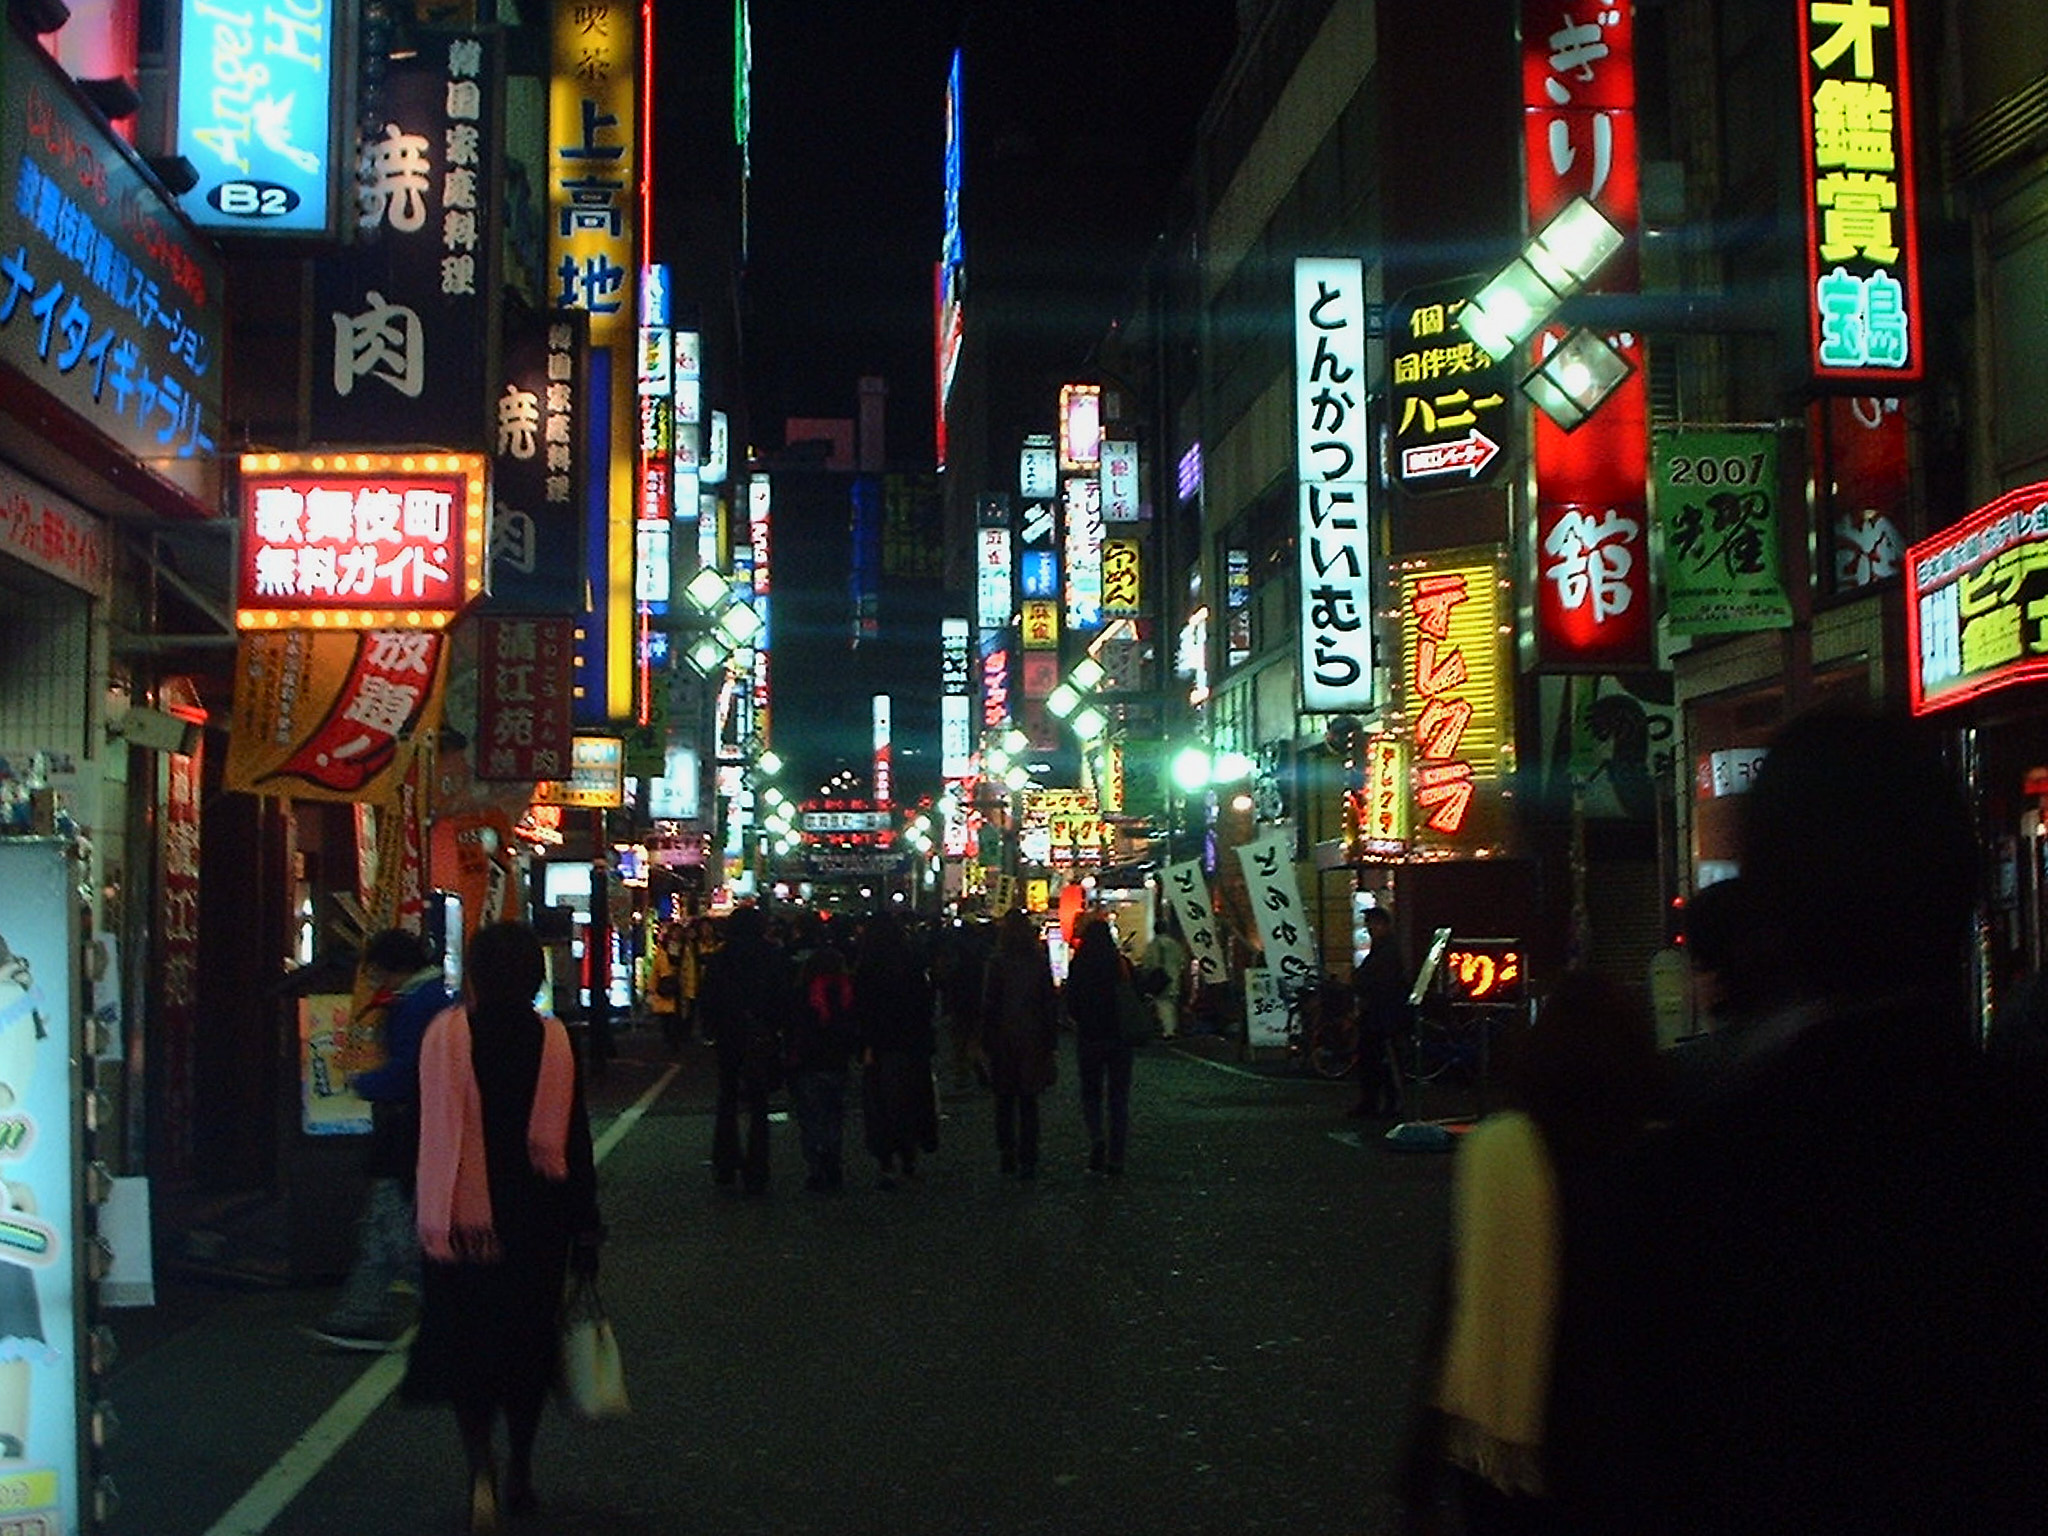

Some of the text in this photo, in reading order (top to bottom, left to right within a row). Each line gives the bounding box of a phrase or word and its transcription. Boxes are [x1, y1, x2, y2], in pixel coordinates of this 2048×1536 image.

[574, 4, 613, 81] 喫茶
[194, 0, 268, 173] Angel
[219, 183, 288, 215] B2
[441, 38, 482, 295] 韓国家庭料理
[557, 99, 626, 315] 上高地
[0, 246, 217, 459] ナイタイギャラリー
[1396, 388, 1505, 437] ハニー
[254, 485, 453, 544] 歌舞伎町
[1308, 280, 1362, 688] とんかつにいむら
[254, 545, 449, 597] 無料ガイド
[1103, 541, 1137, 605] らーめん
[1412, 573, 1476, 835] テレクラ
[1378, 747, 1394, 834] テレクラ
